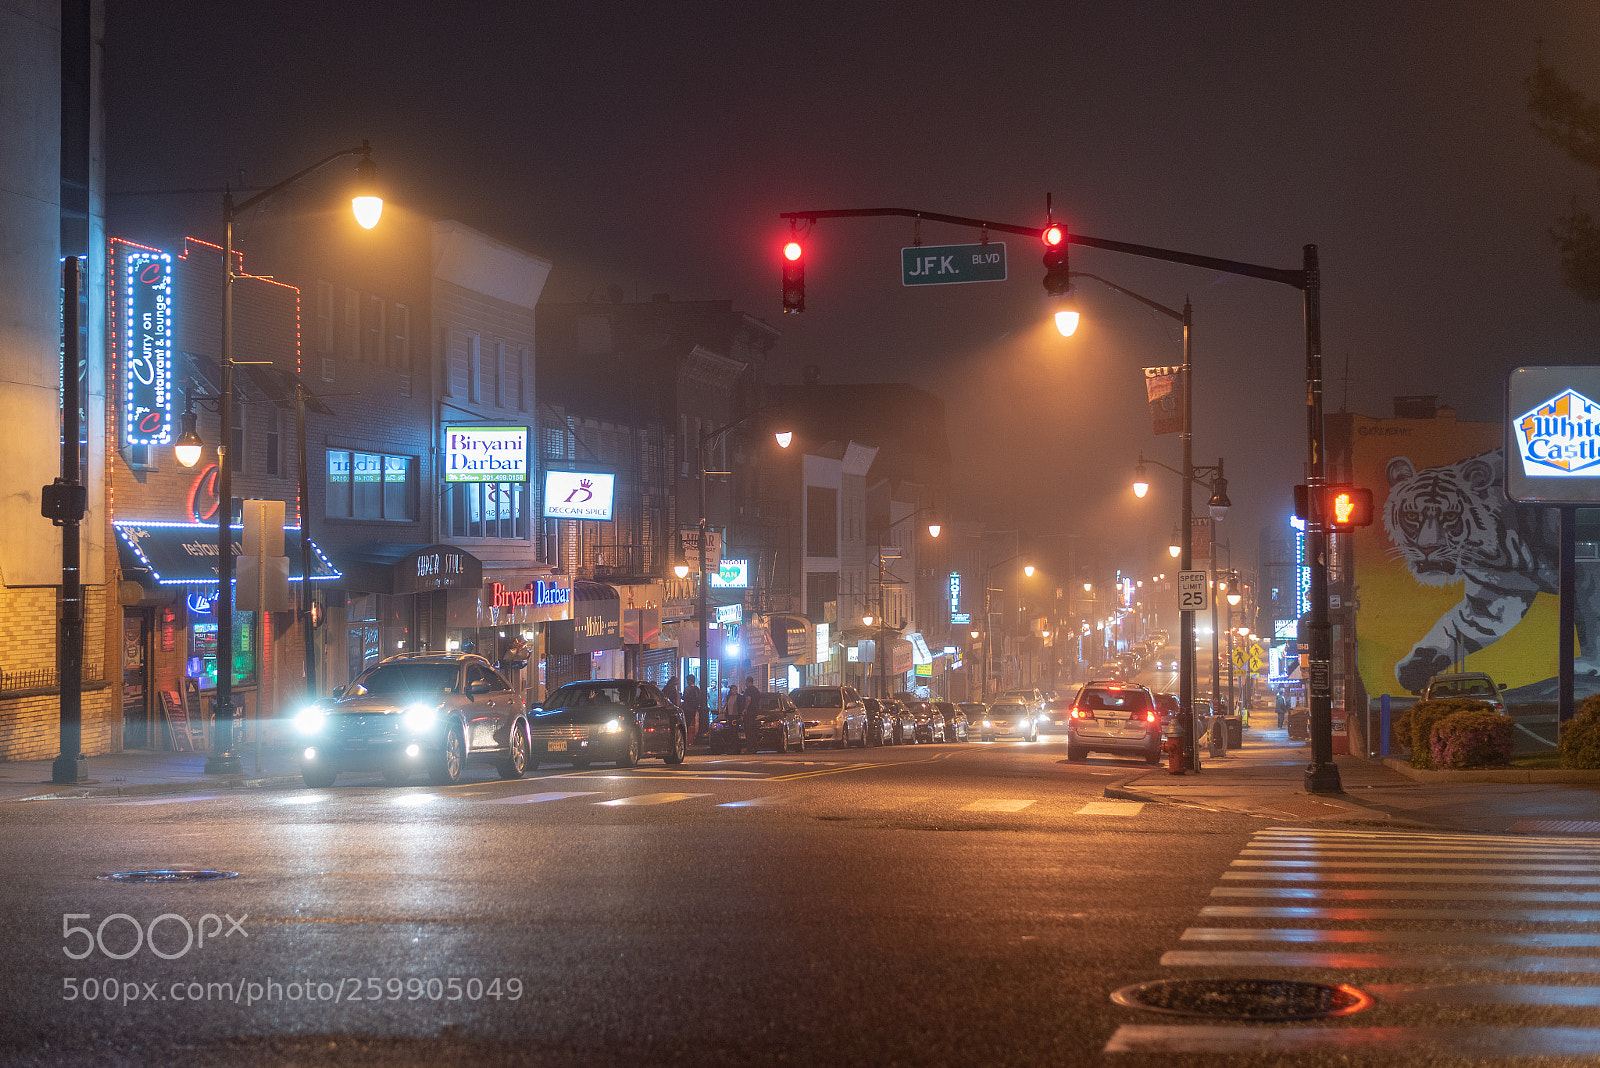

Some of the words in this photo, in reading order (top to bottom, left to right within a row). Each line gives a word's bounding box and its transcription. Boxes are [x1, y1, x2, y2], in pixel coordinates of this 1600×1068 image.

[908, 255, 959, 276] J.F.K.
[972, 253, 1000, 264] BLVD
[143, 312, 152, 330] on
[155, 295, 167, 336] lounge
[132, 333, 155, 385] Curry
[154, 346, 165, 408] restaurant
[451, 434, 522, 455] Biryani
[1527, 438, 1600, 460] Castl
[450, 453, 523, 470] Darbar
[548, 506, 583, 515] DECCAN
[585, 508, 607, 516] SPICE
[417, 553, 440, 577] SUPER
[445, 553, 464, 574] STYLE
[720, 571, 738, 579] PAN
[1180, 574, 1205, 582] SPEED
[493, 581, 534, 614] Biryani
[536, 580, 571, 606] Darbar
[950, 577, 960, 613] HOTEL
[1182, 591, 1203, 606] 25
